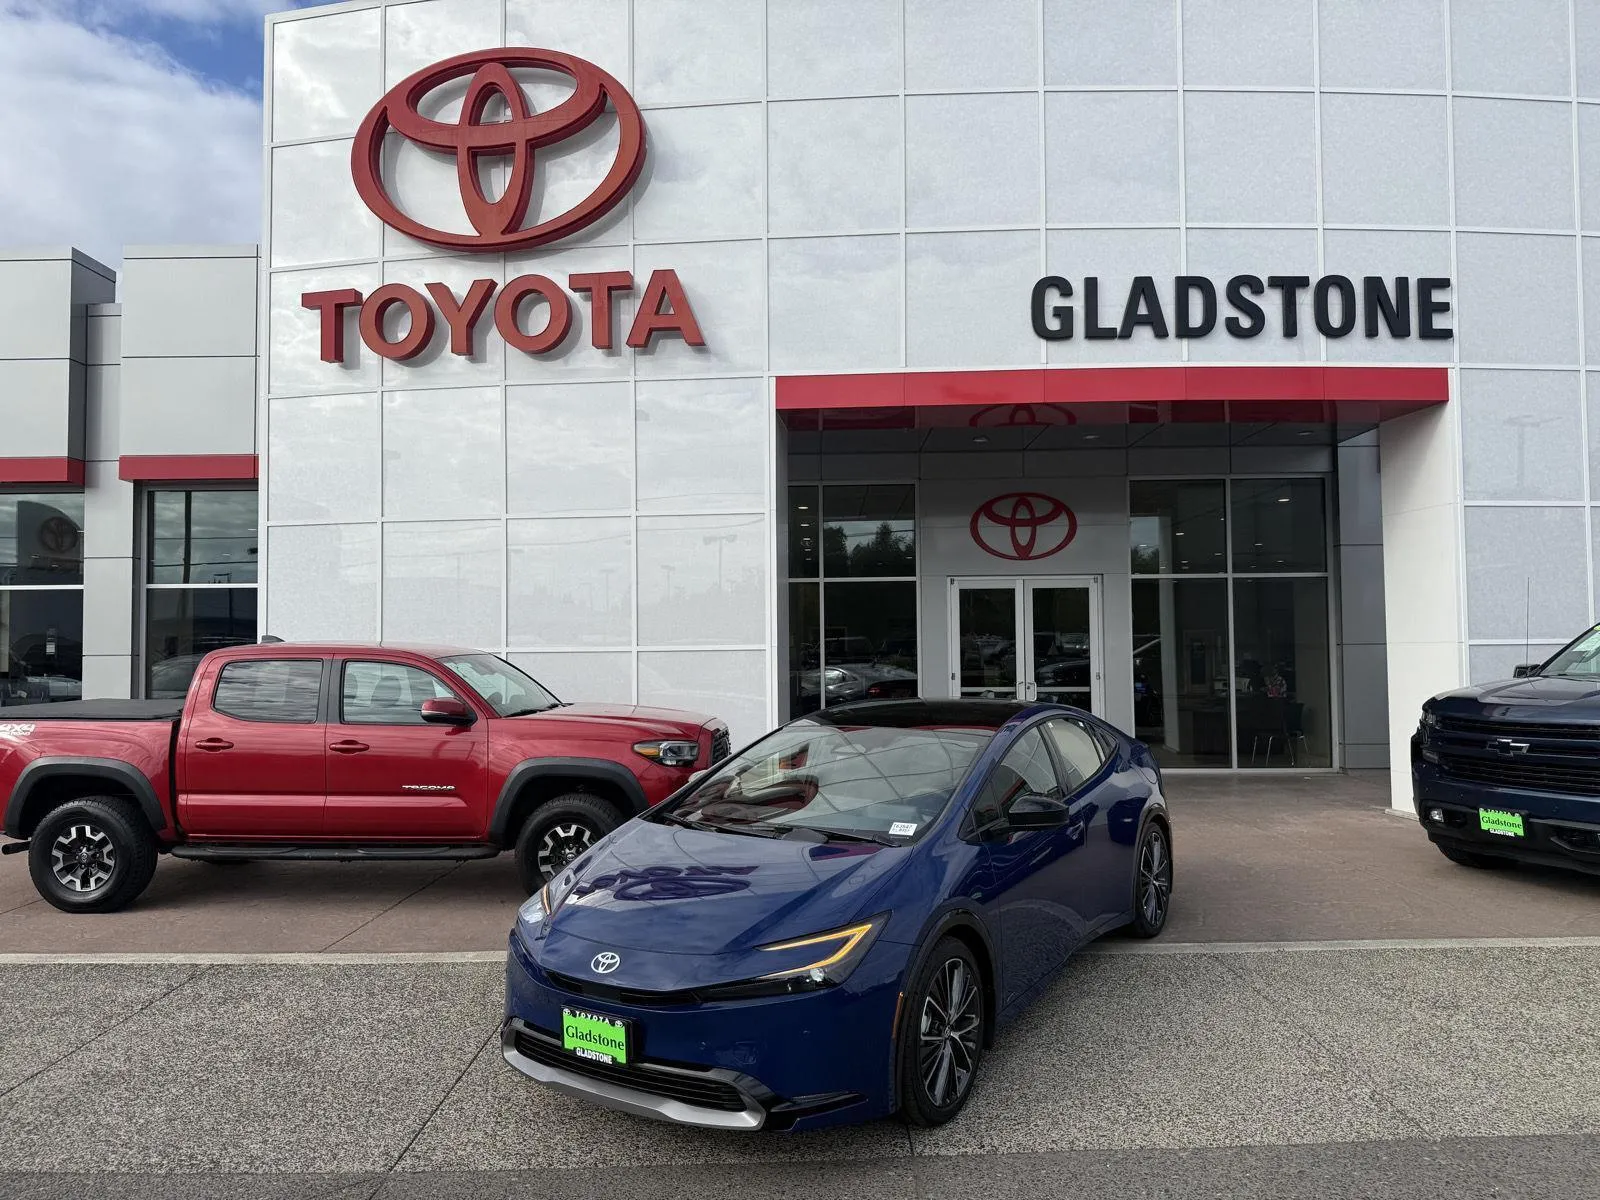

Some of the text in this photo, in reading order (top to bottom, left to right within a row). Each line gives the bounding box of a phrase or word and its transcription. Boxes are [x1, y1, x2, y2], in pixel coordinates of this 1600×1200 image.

[301, 269, 706, 363] TOYOTA
[1031, 274, 1454, 340] GLADSTONE
[1481, 816, 1522, 829] Gladstone
[575, 1010, 611, 1025] TOYOTA
[565, 1025, 625, 1051] Gladstone
[576, 1047, 613, 1065] GLADSTONE
